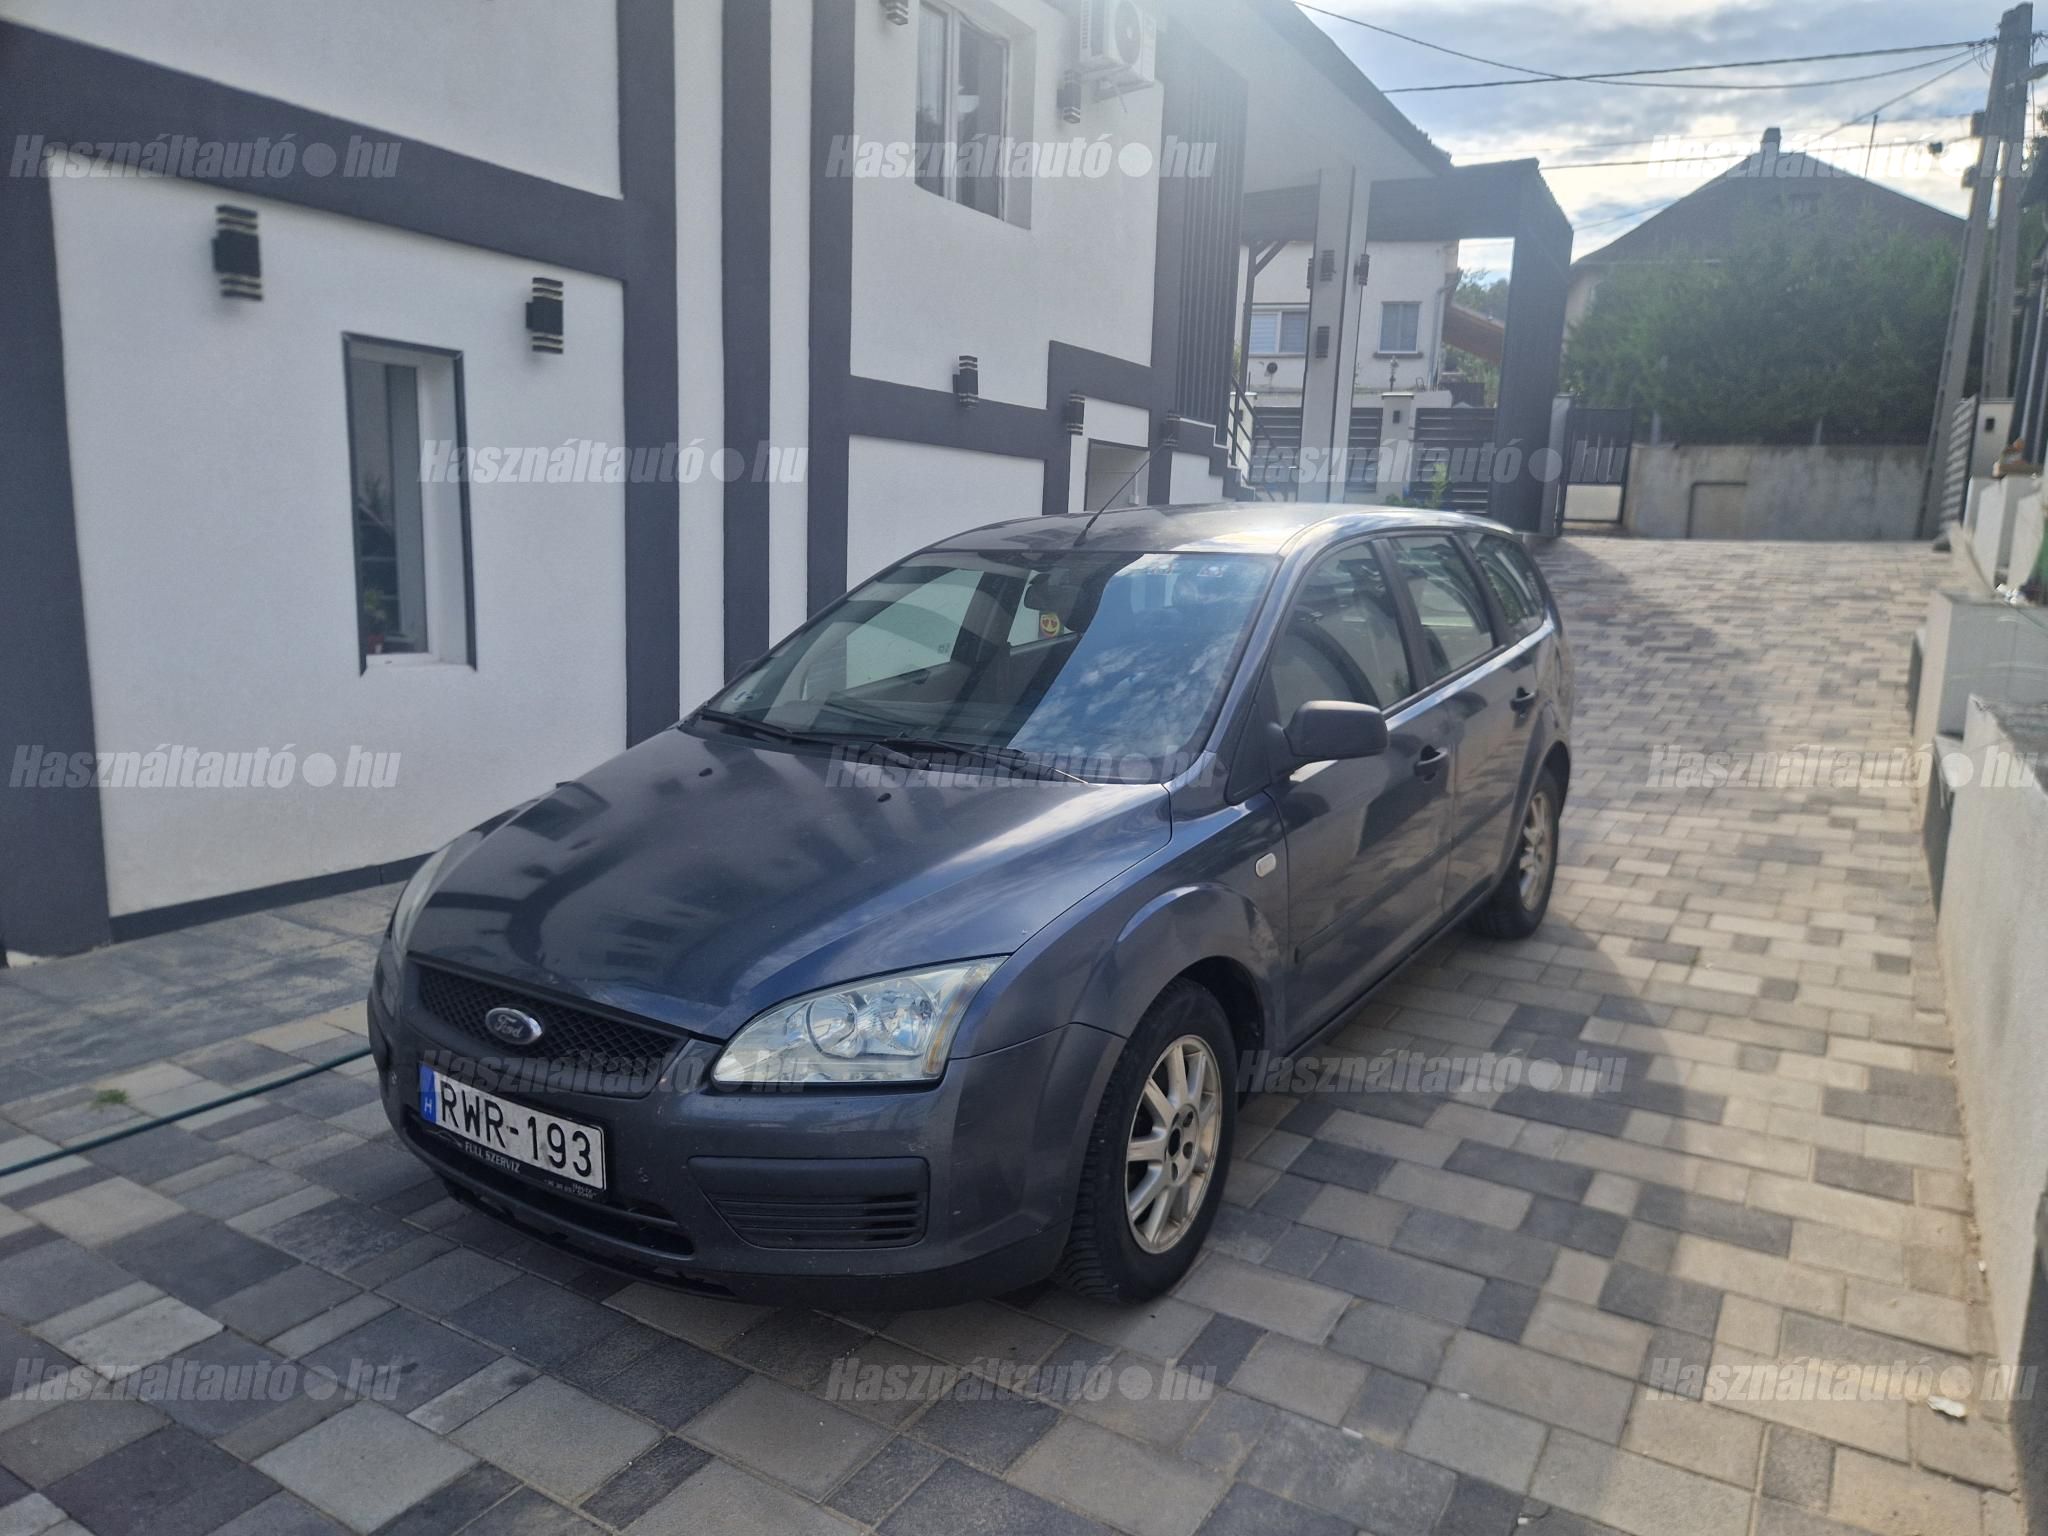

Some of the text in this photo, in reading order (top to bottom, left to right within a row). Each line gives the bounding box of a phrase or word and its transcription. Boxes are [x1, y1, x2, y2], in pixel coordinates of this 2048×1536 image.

[497, 1015, 523, 1039] Ford
[424, 1098, 432, 1114] H
[440, 1080, 592, 1178] RWR-193
[465, 1141, 520, 1174] FULL SZERVIZ
